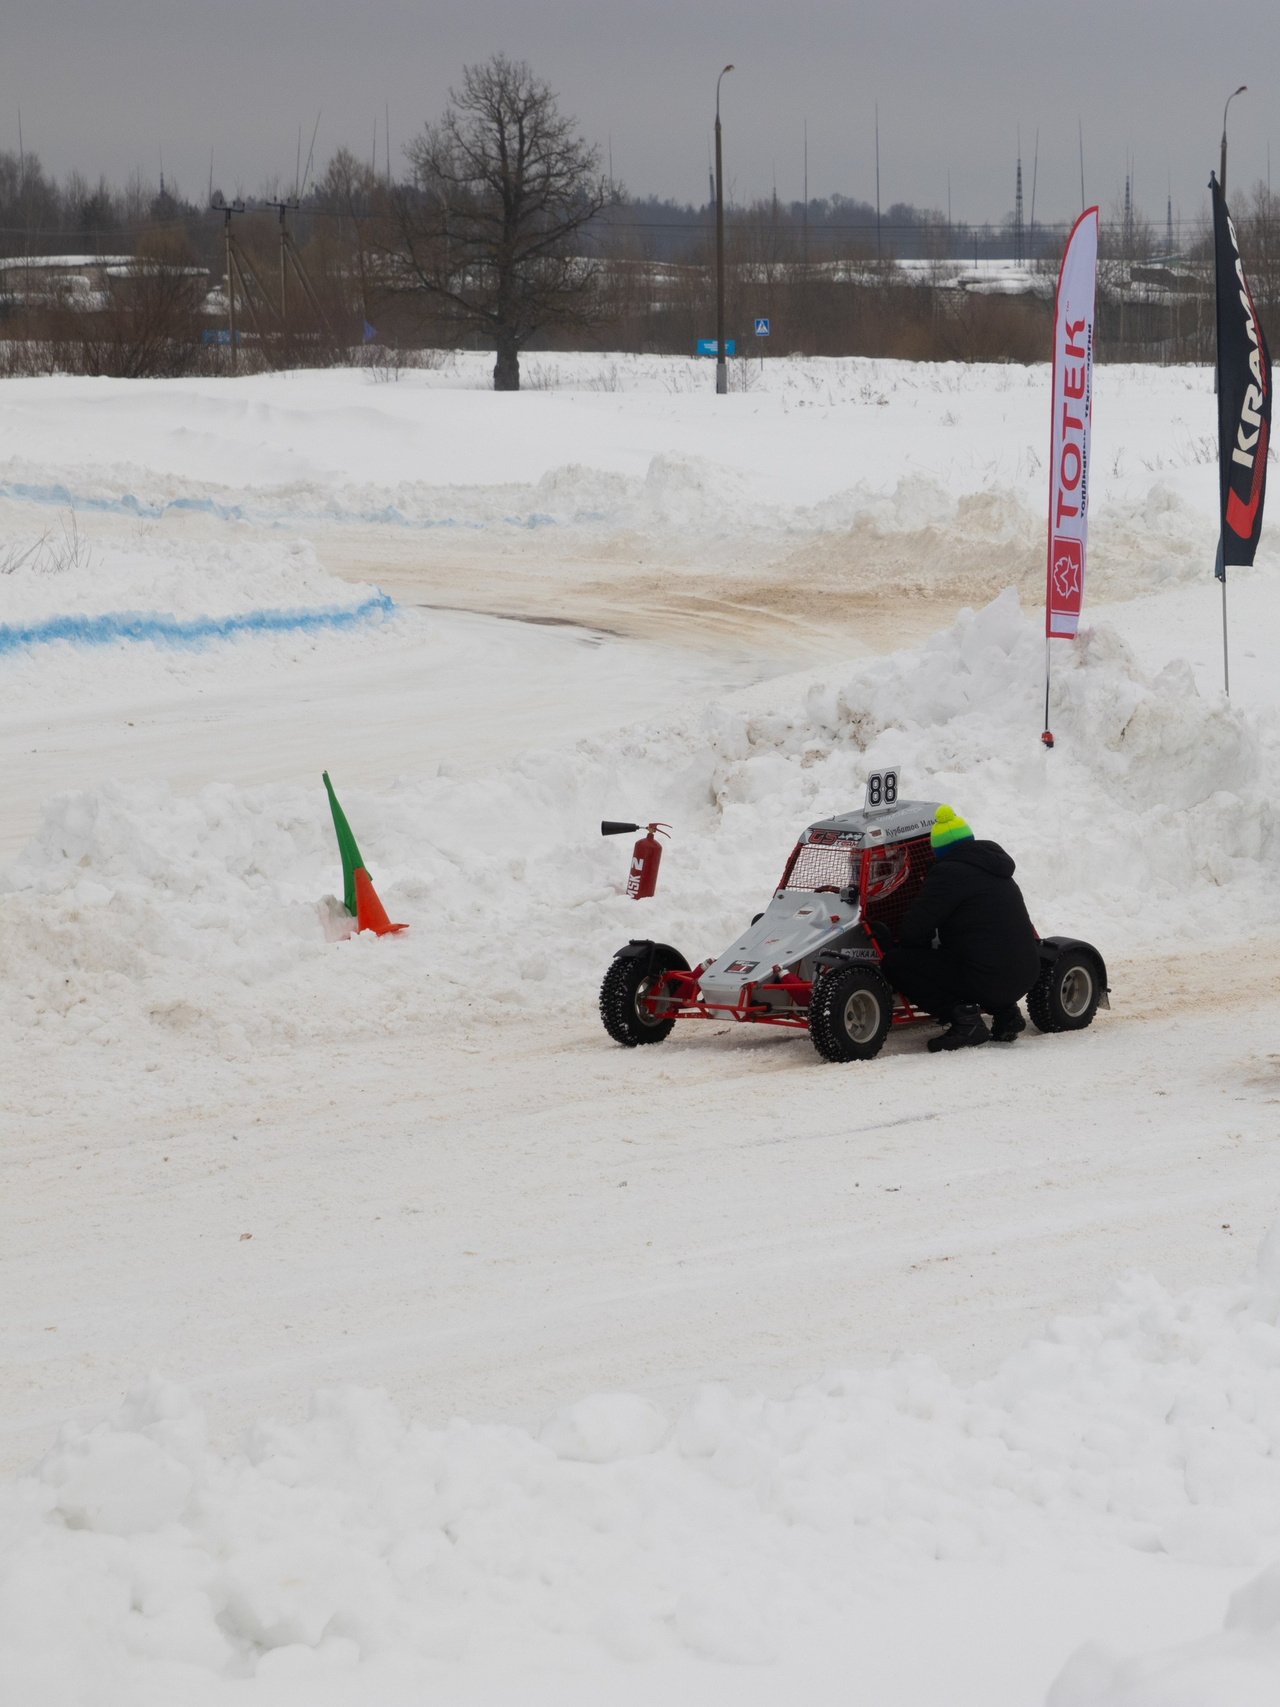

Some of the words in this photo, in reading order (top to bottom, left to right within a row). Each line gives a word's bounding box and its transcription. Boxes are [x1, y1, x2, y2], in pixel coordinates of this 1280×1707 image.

[869, 771, 898, 807] 88
[885, 824, 920, 838] Курбатов
[631, 857, 645, 871] 2
[852, 950, 870, 958] YUKA
